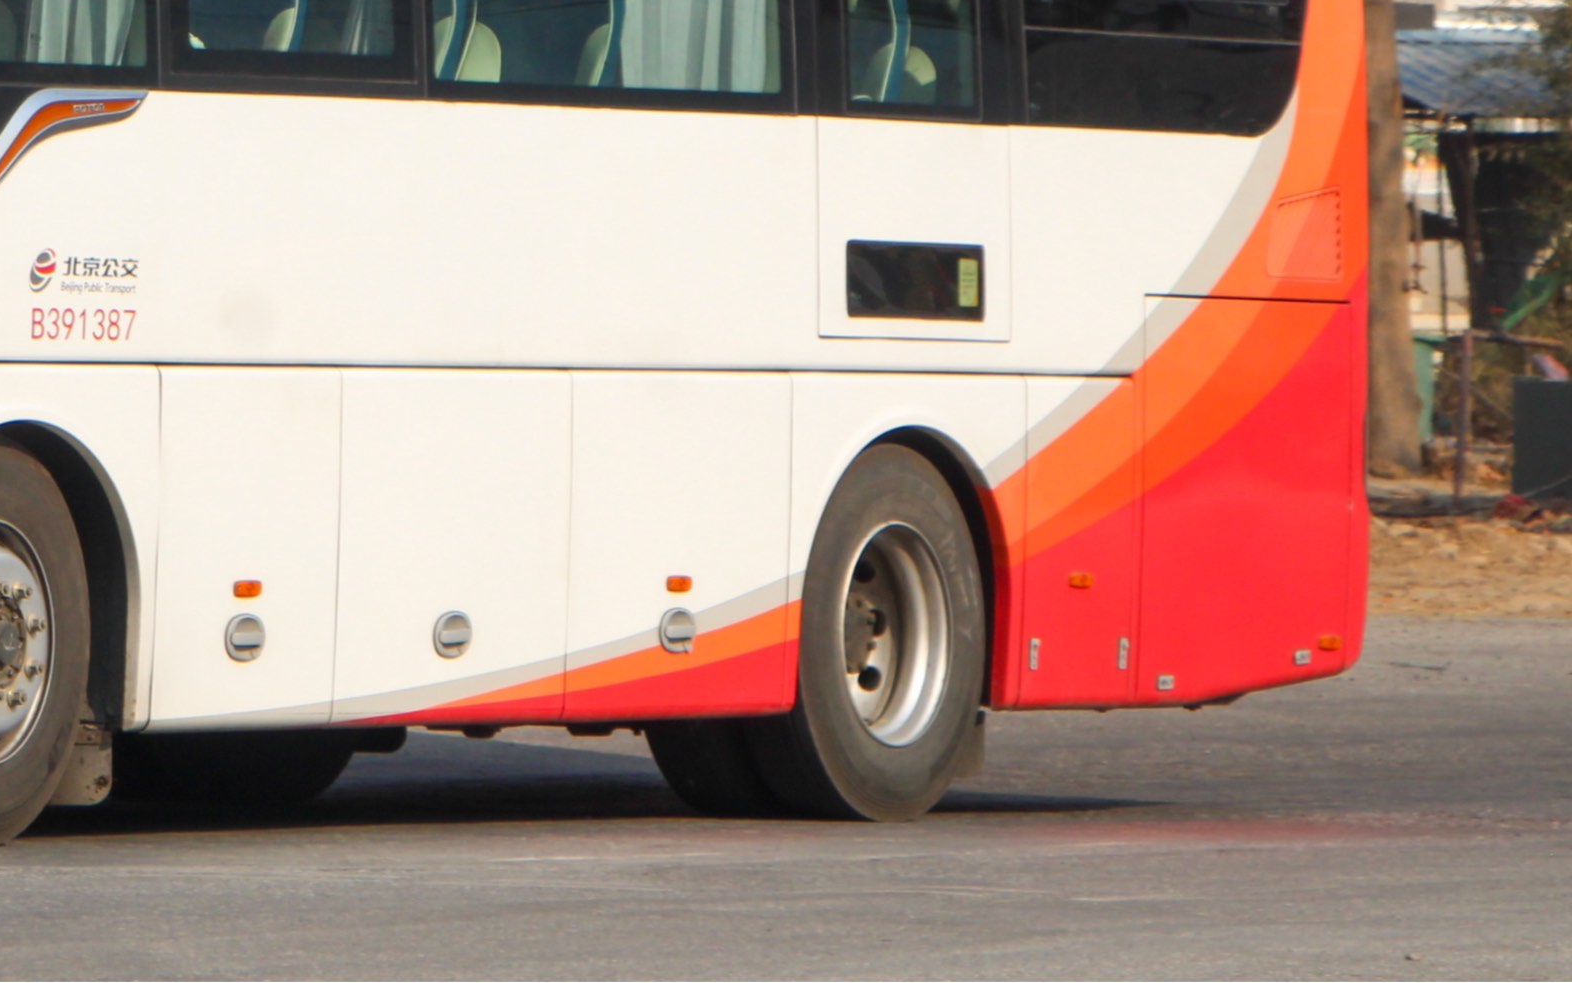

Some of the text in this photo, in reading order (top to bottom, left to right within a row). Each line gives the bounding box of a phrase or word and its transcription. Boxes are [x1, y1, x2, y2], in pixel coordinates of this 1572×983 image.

[62, 257, 139, 278] 北京公交
[60, 281, 136, 295] Beijing Public Transport
[31, 307, 137, 341] B391387
